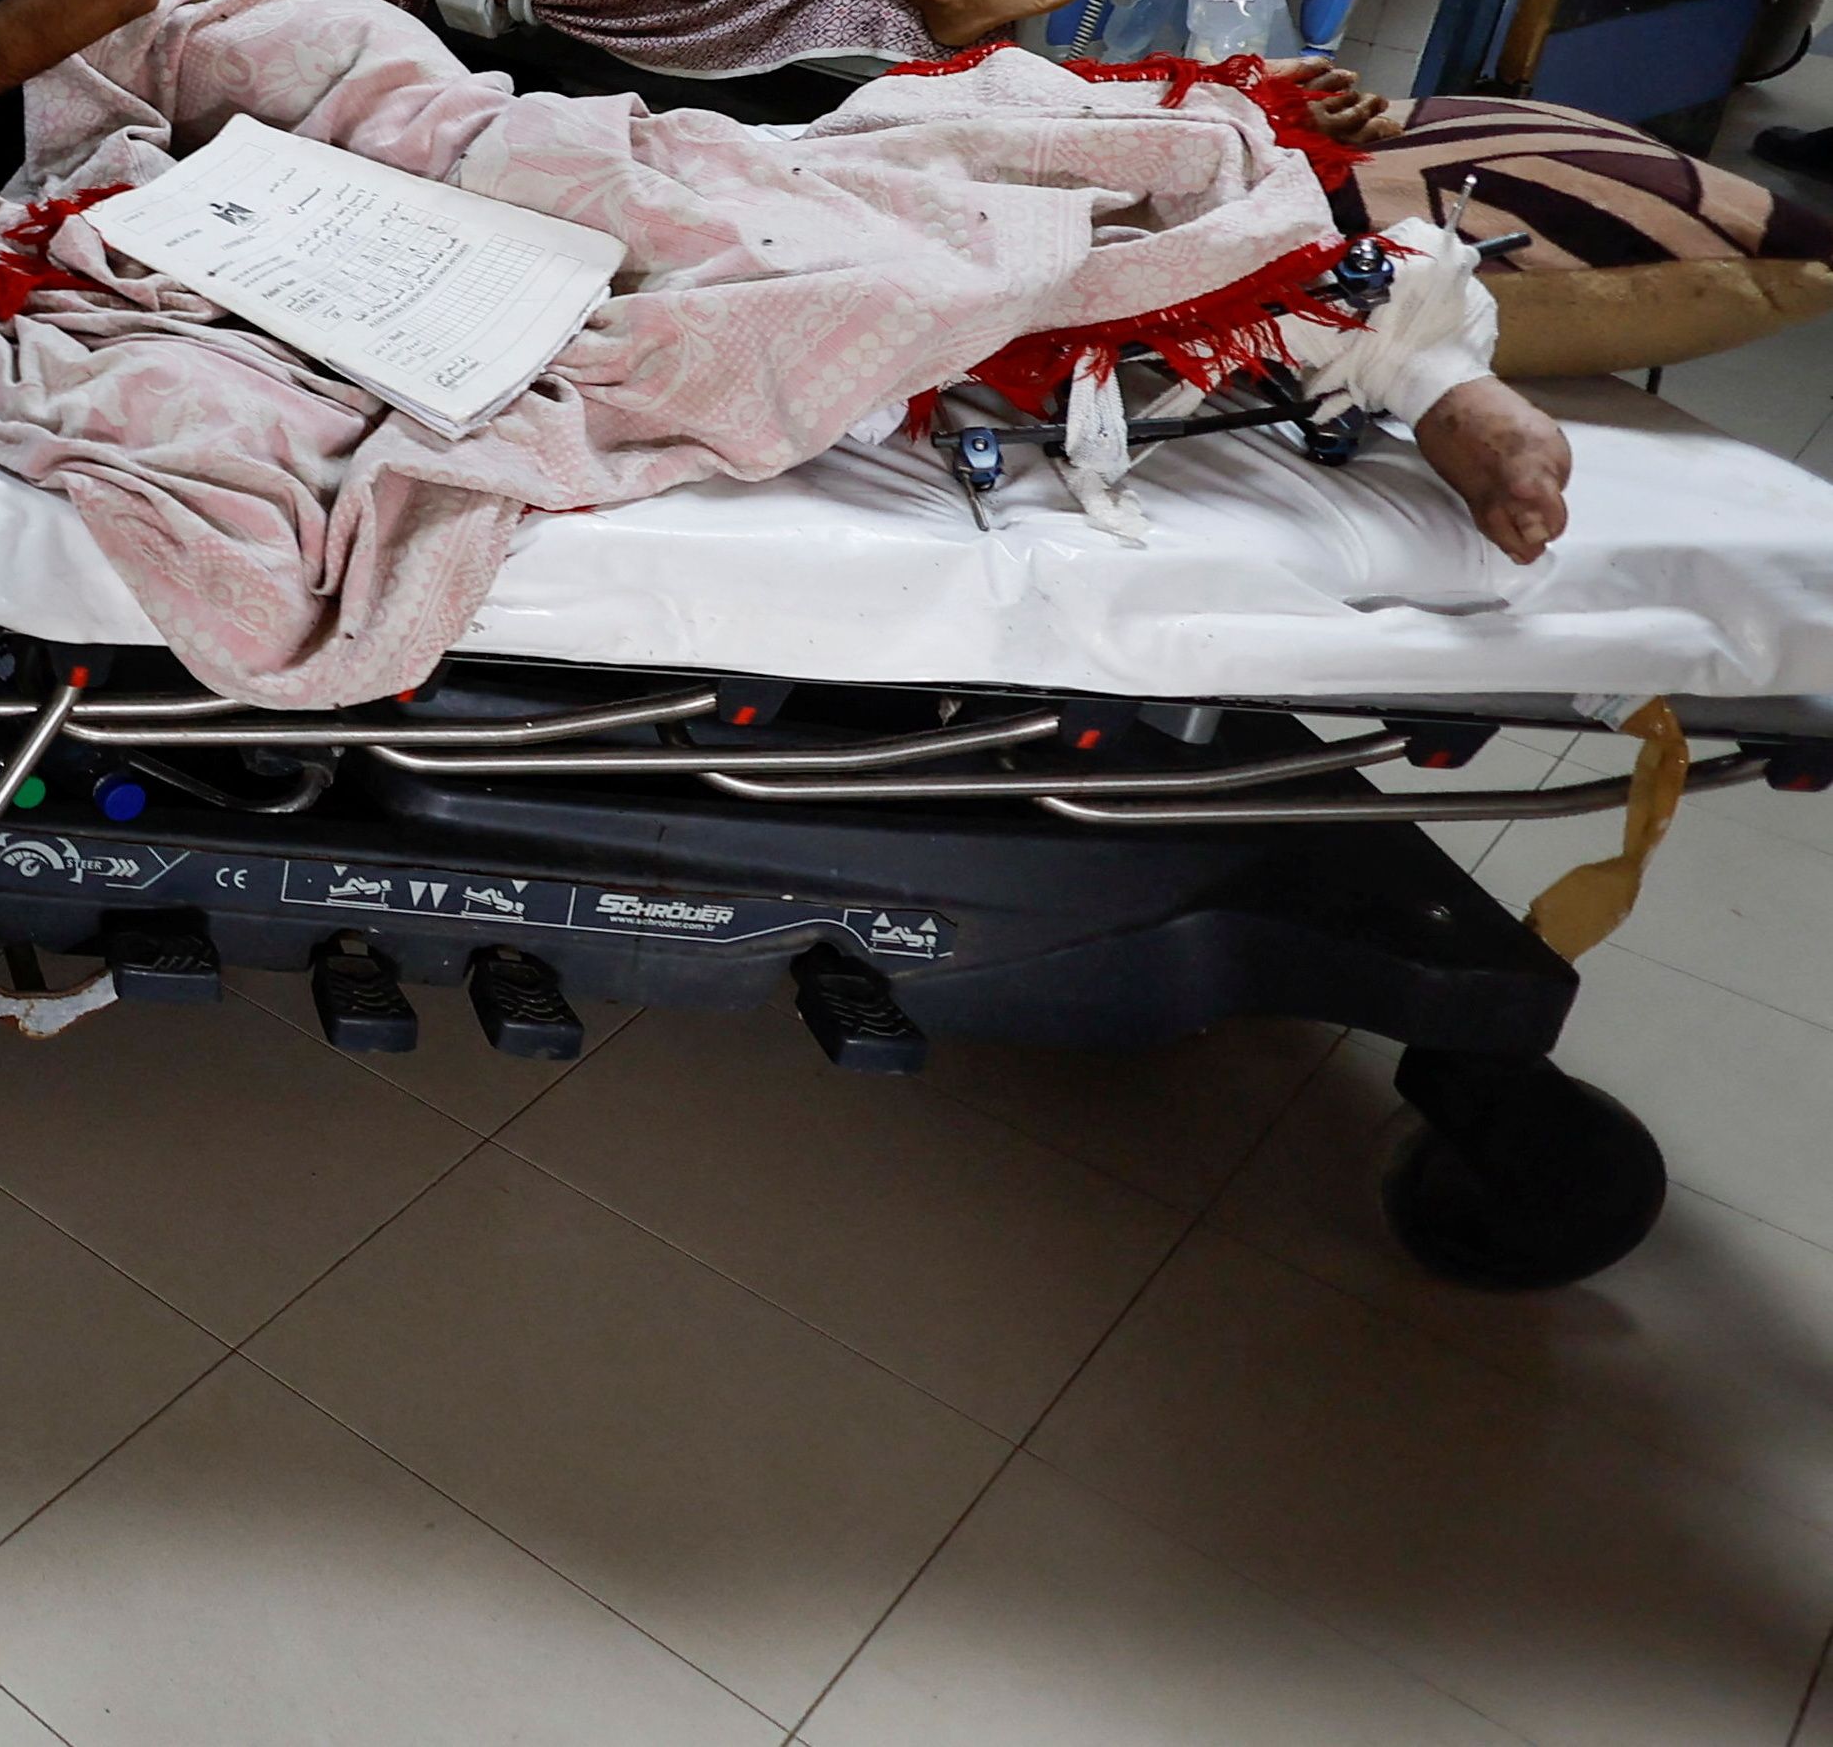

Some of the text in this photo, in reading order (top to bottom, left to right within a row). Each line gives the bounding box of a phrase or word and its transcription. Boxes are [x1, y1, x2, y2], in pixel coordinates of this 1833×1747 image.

[67, 858, 102, 871] STEER
[216, 868, 247, 888] CE
[596, 893, 735, 925] SCHRÖDER
